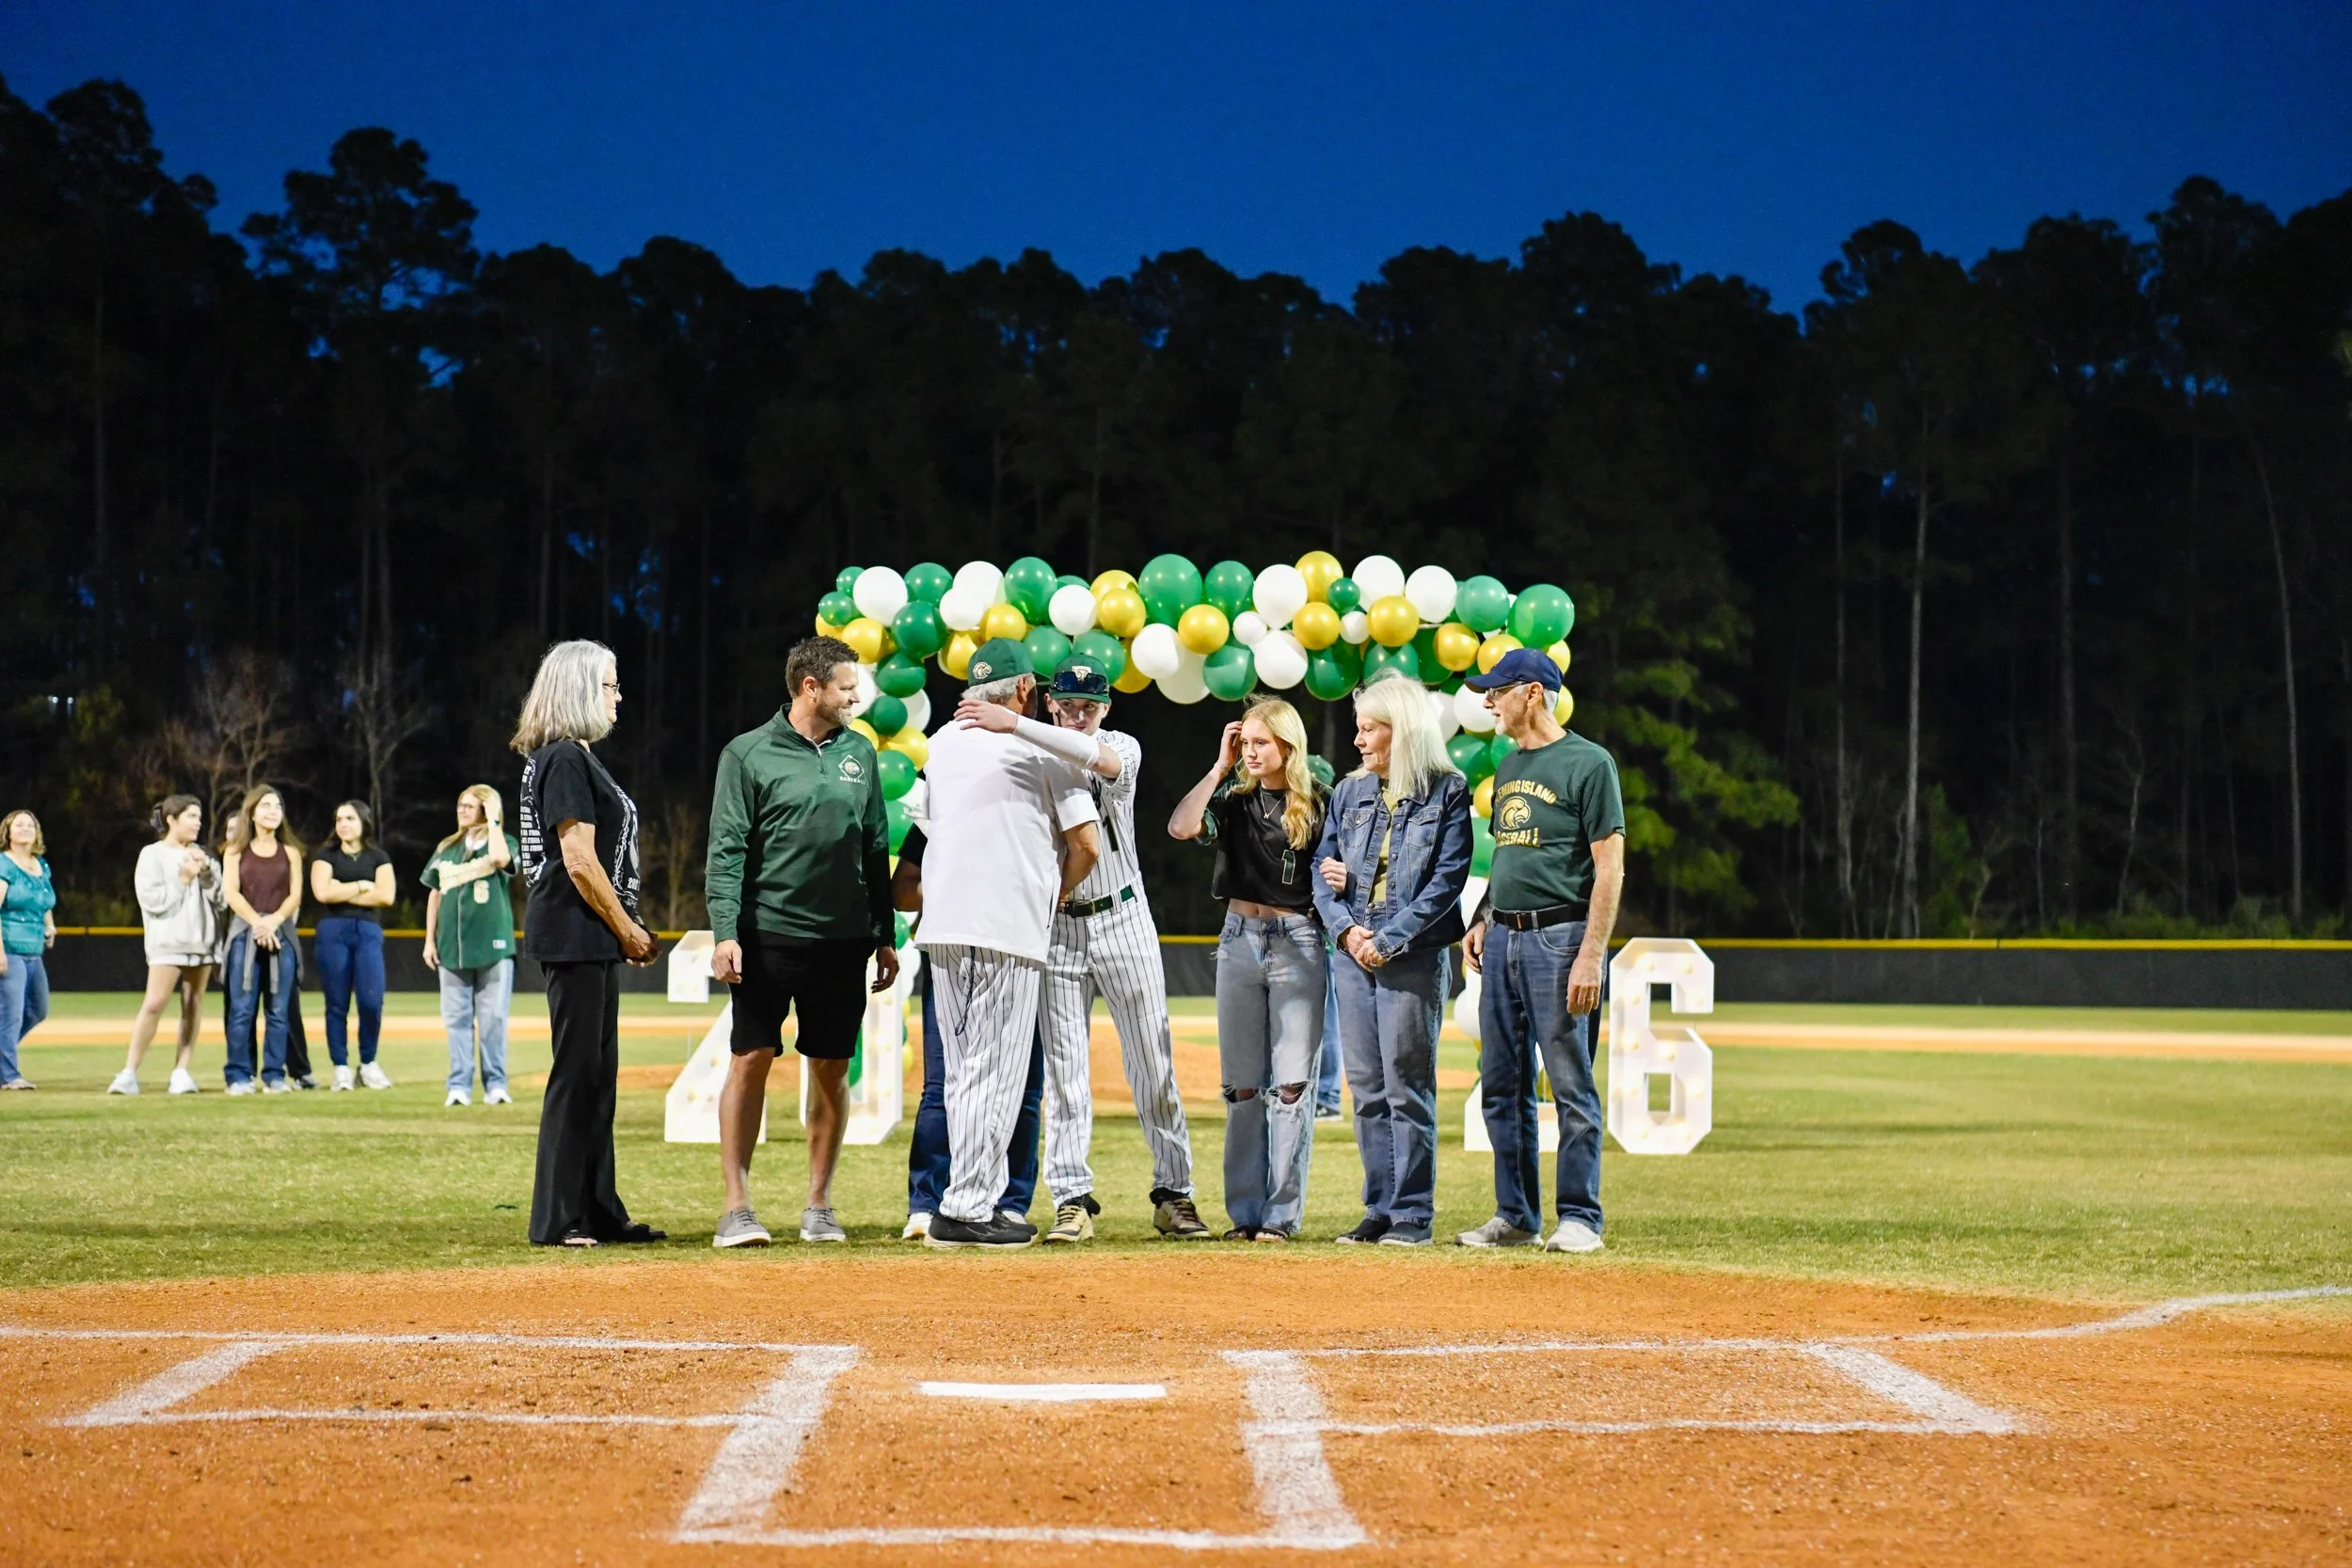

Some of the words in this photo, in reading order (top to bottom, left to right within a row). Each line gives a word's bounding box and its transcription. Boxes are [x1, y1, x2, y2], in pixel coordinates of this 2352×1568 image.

[839, 776, 866, 785] BASEBALL
[1520, 780, 1557, 805] ISLAND
[1281, 848, 1295, 884] 1
